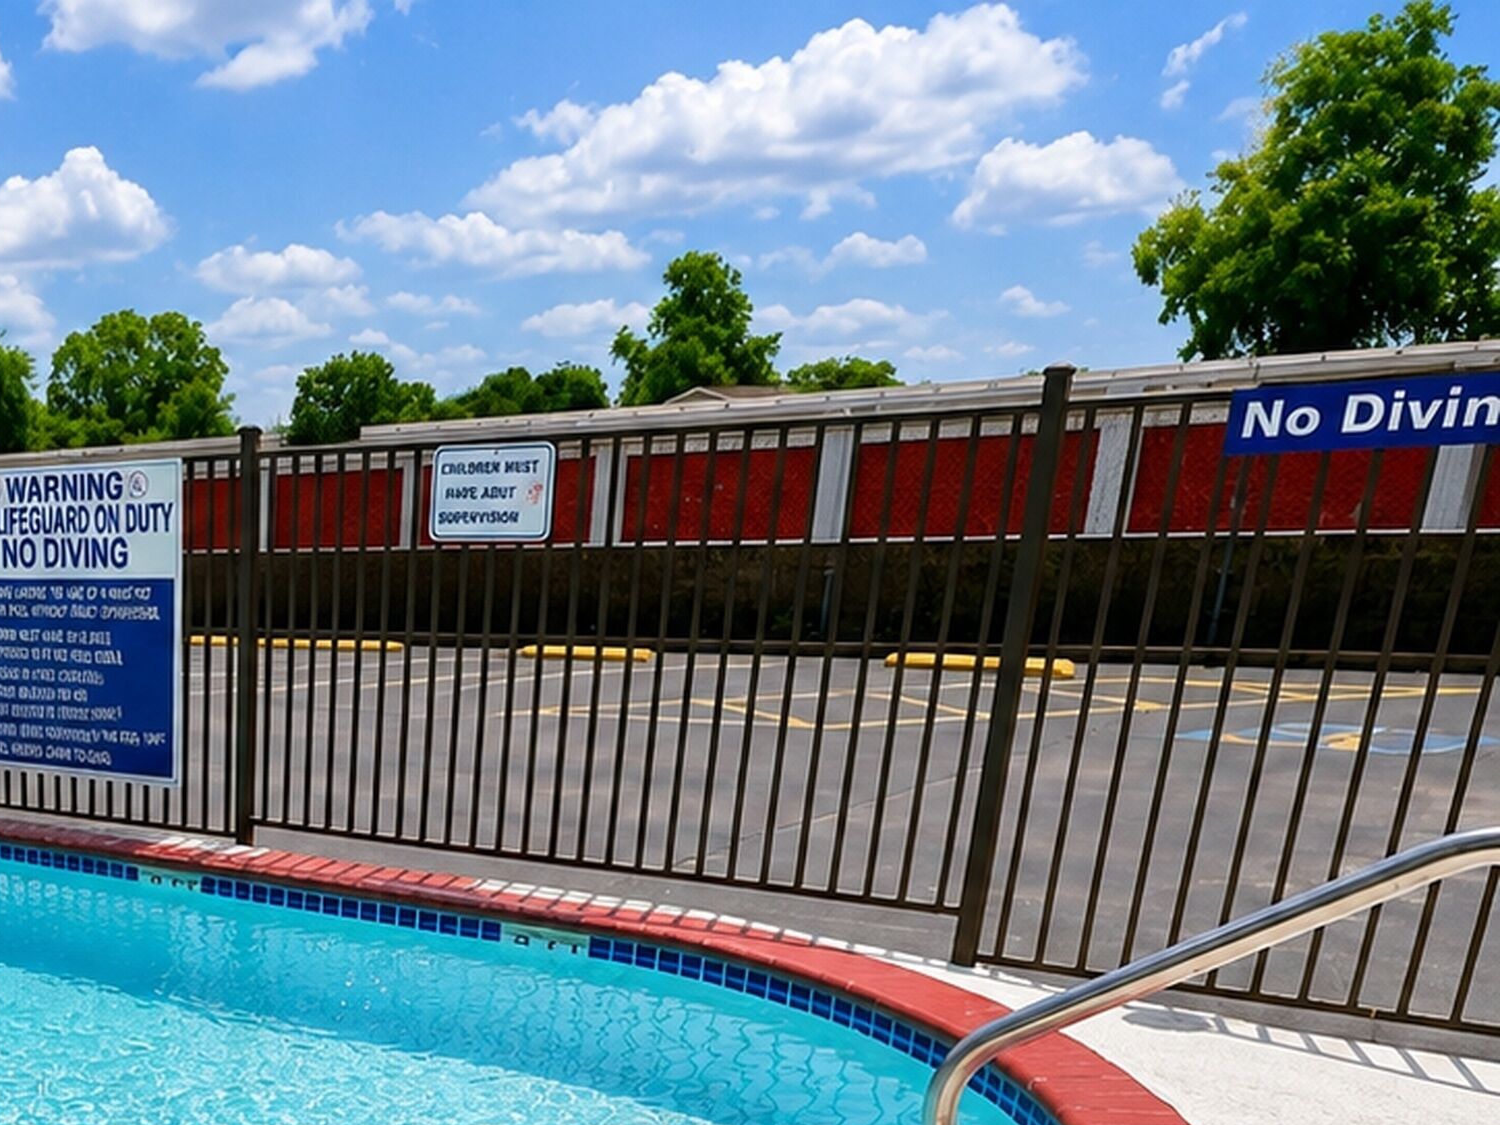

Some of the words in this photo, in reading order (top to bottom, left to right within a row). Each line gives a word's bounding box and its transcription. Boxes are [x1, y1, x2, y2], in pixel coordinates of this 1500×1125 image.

[1241, 399, 1321, 439] No
[6, 471, 123, 503] WARNING
[94, 504, 119, 534] ON
[126, 502, 173, 533] DUTY
[2, 537, 36, 569] NO
[43, 536, 129, 569] DIVING
